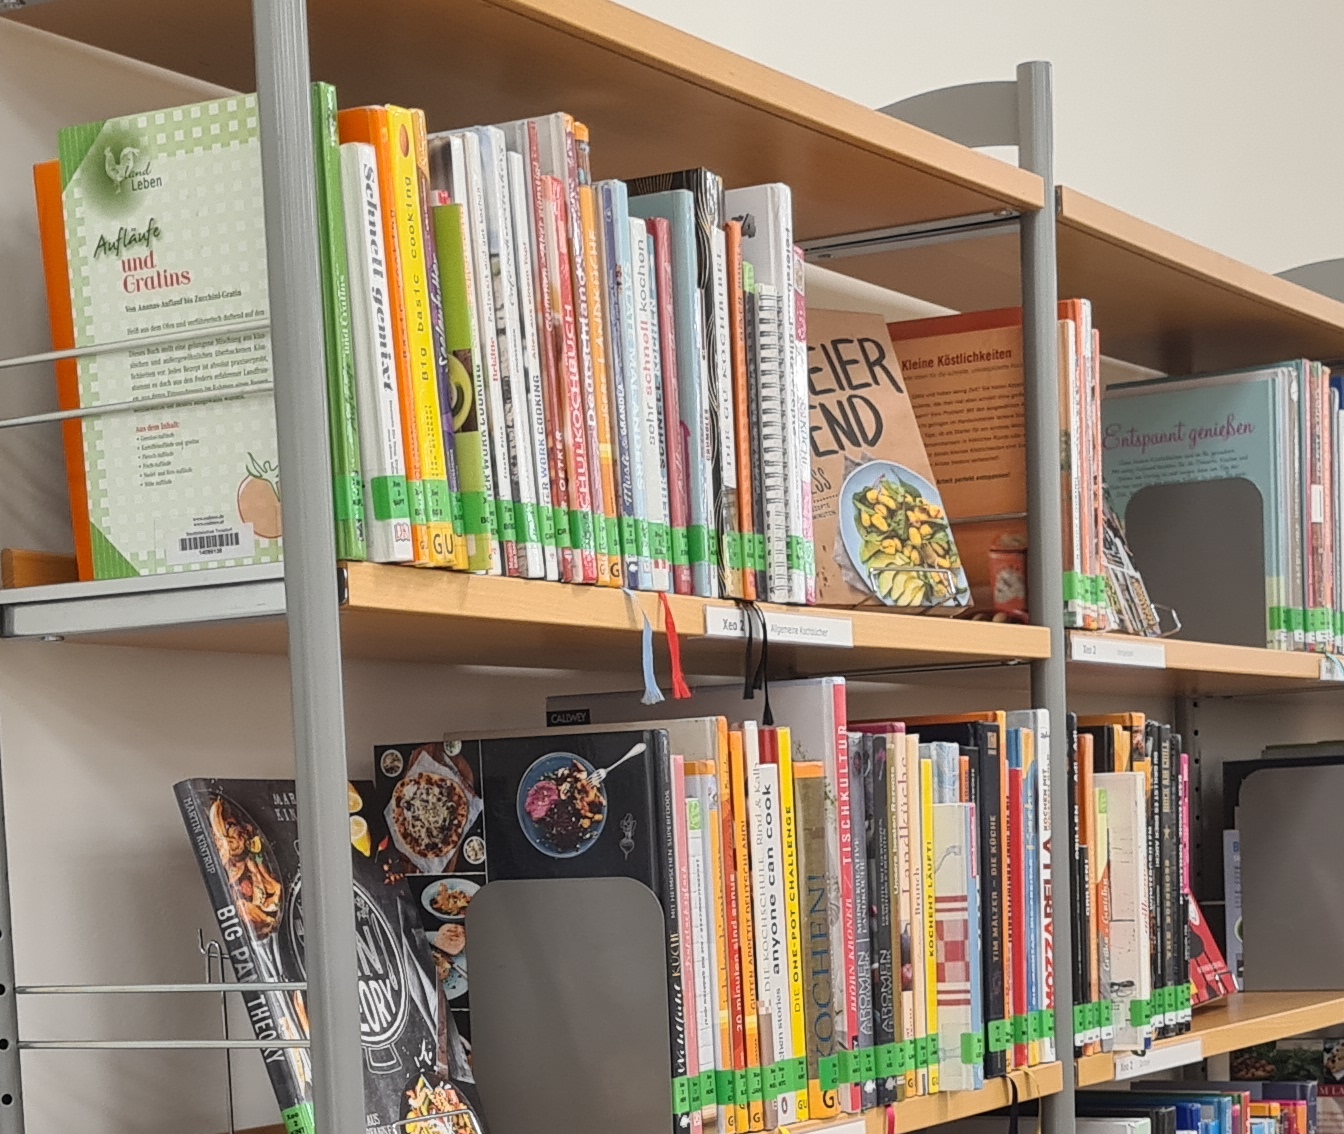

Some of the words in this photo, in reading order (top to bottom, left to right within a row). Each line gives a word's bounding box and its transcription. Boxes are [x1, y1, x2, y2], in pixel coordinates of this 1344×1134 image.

[122, 162, 153, 181] land
[131, 175, 163, 192] Leben
[93, 218, 161, 259] Aufläufe
[362, 162, 384, 279] Schnell
[405, 176, 417, 260] cooking
[122, 250, 156, 273] und
[123, 270, 191, 294] Gratins
[413, 274, 424, 333] basic
[371, 286, 394, 392] gemixt
[901, 356, 935, 372] Kleine
[937, 348, 1013, 368] Köstlichkeiten
[532, 375, 545, 434] COOKING
[562, 303, 592, 512] CHULKOCHBUCH
[616, 383, 627, 436] GRANOLA
[1103, 420, 1186, 453] Entspannt
[1186, 413, 1255, 449] genießen
[539, 438, 548, 478] WORK
[557, 430, 568, 492] OETKER
[432, 532, 454, 555] GU
[723, 618, 737, 632] Xeo
[771, 622, 799, 638] Allgemeine
[799, 624, 830, 638] Kochbücher
[550, 712, 587, 724] CALLWEY
[762, 783, 774, 839] cook
[838, 724, 853, 866] TISCHKULTUR
[183, 796, 201, 836] MARTIN
[196, 834, 216, 875] KINTRUP
[664, 789, 674, 847] SUPERFOODS
[754, 814, 764, 846] Rind
[987, 814, 998, 854] KÜCHE
[765, 846, 775, 887] can
[784, 805, 796, 903] CHALLENGE
[924, 840, 934, 888] LÄUFT!
[988, 856, 998, 876] DIE
[756, 856, 771, 961] KOCHSCHULE
[912, 867, 922, 916] Brunch
[989, 891, 1000, 936] MÄLZER
[217, 903, 244, 942] BIG
[729, 921, 739, 951] sind
[767, 893, 781, 975] anyone
[926, 893, 935, 958] KOCHEN?
[1041, 837, 1056, 1011] MOZZARELLA
[669, 932, 682, 978] KÜCHE
[788, 909, 800, 983] ONE-POT
[991, 940, 1001, 963] TIM
[792, 988, 801, 1013] DIE
[856, 951, 866, 1036] AROMEN
[879, 949, 890, 1033] AROMEN
[735, 1014, 744, 1032] 20
[775, 1030, 785, 1059] chen
[286, 1111, 299, 1121] Xeo
